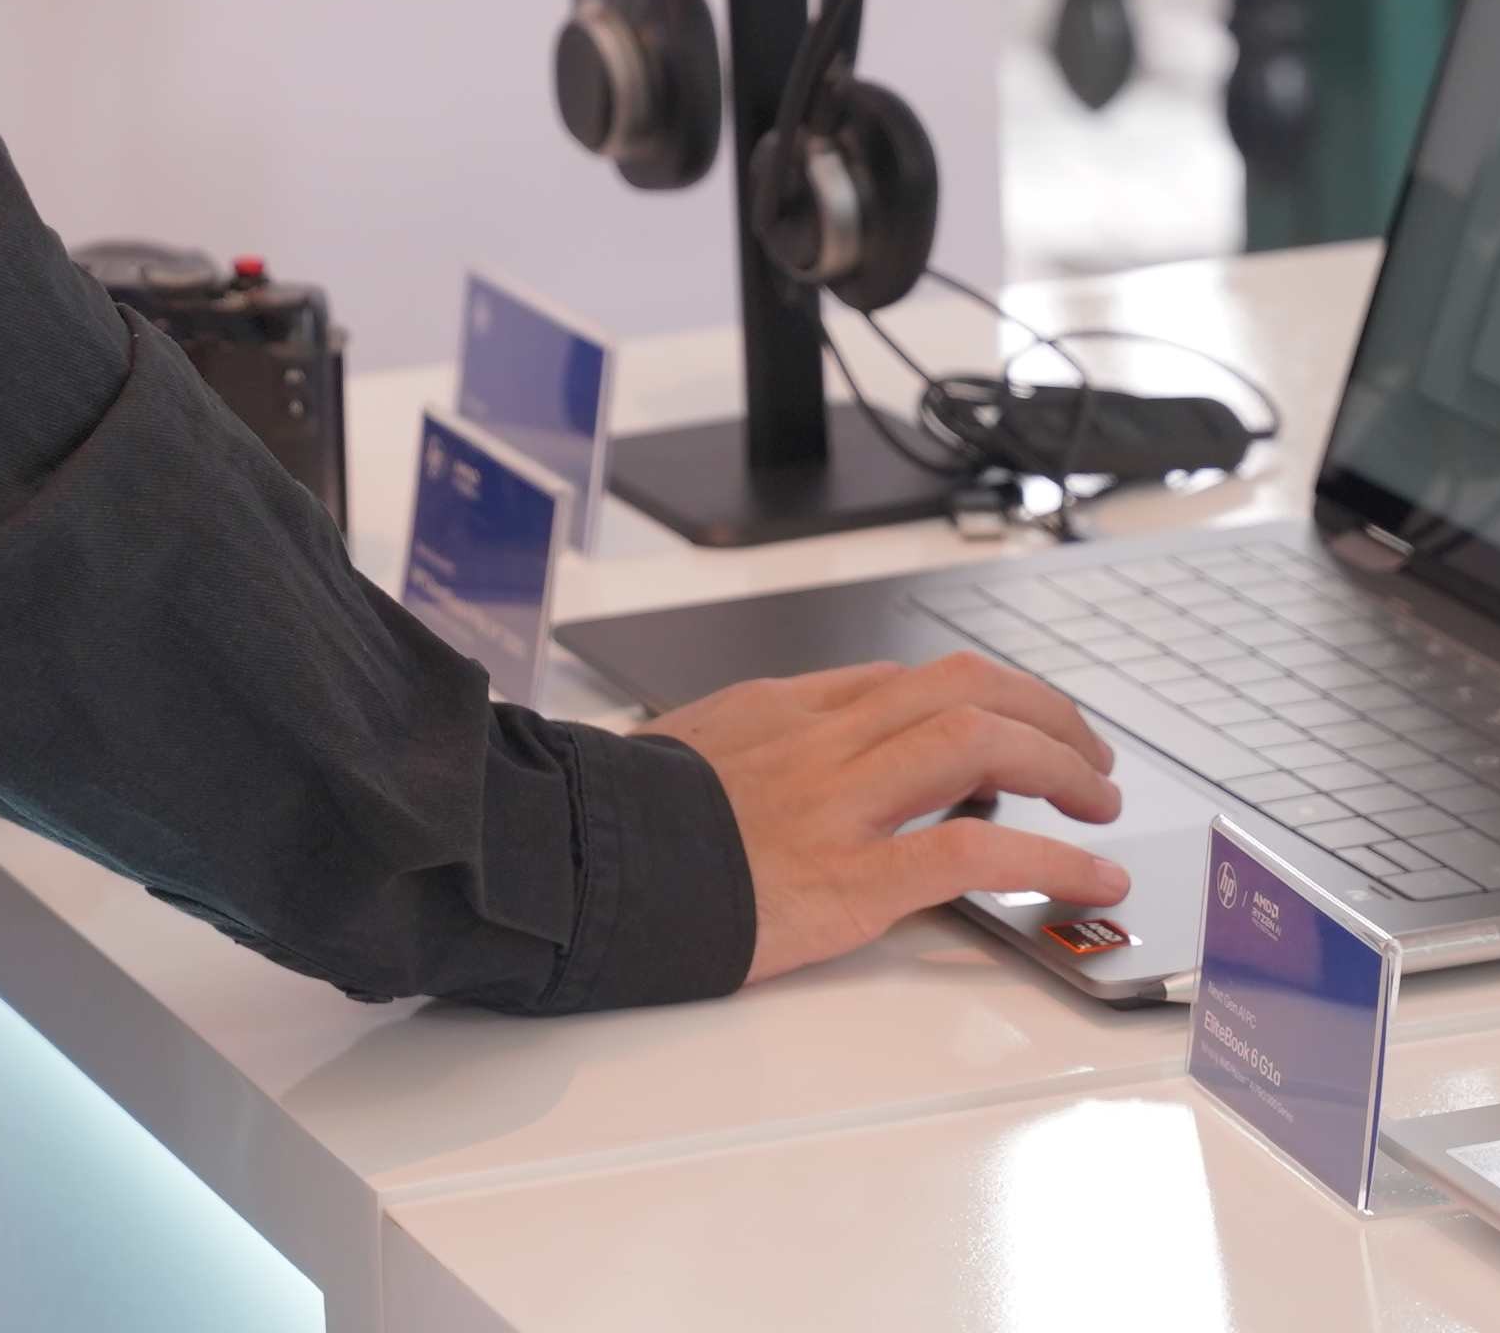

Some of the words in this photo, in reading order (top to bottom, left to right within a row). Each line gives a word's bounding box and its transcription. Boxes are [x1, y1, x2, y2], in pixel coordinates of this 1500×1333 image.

[1218, 862, 1236, 908] hp
[1204, 1010, 1250, 1062] EliteBook
[1250, 1048, 1258, 1068] 6
